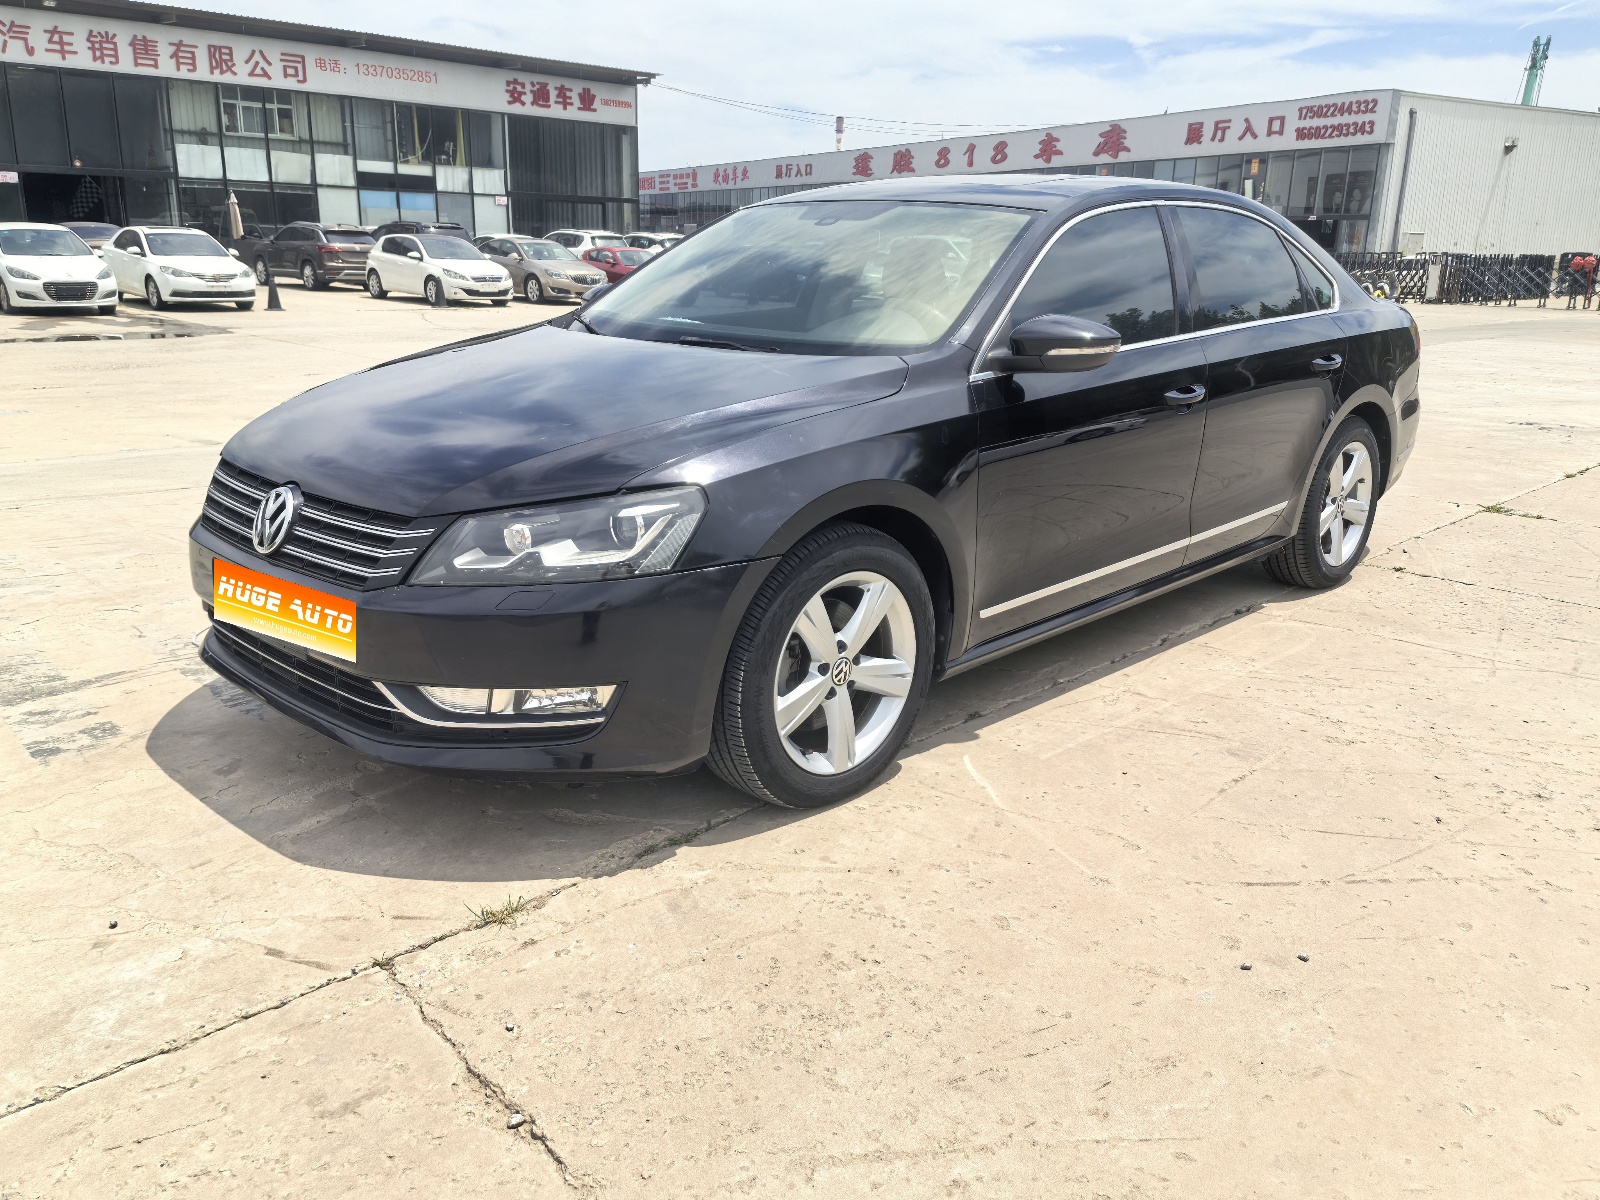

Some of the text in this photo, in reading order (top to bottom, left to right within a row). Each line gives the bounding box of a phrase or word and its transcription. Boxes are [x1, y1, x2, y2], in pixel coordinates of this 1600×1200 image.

[0, 19, 308, 84] 汽车销售有限公司
[504, 77, 598, 113] 安通车业
[1297, 97, 1379, 121] 17502244332
[1184, 115, 1286, 146] 展厅入口
[1294, 119, 1376, 142] 16602293343
[774, 163, 813, 180] 展厅入口
